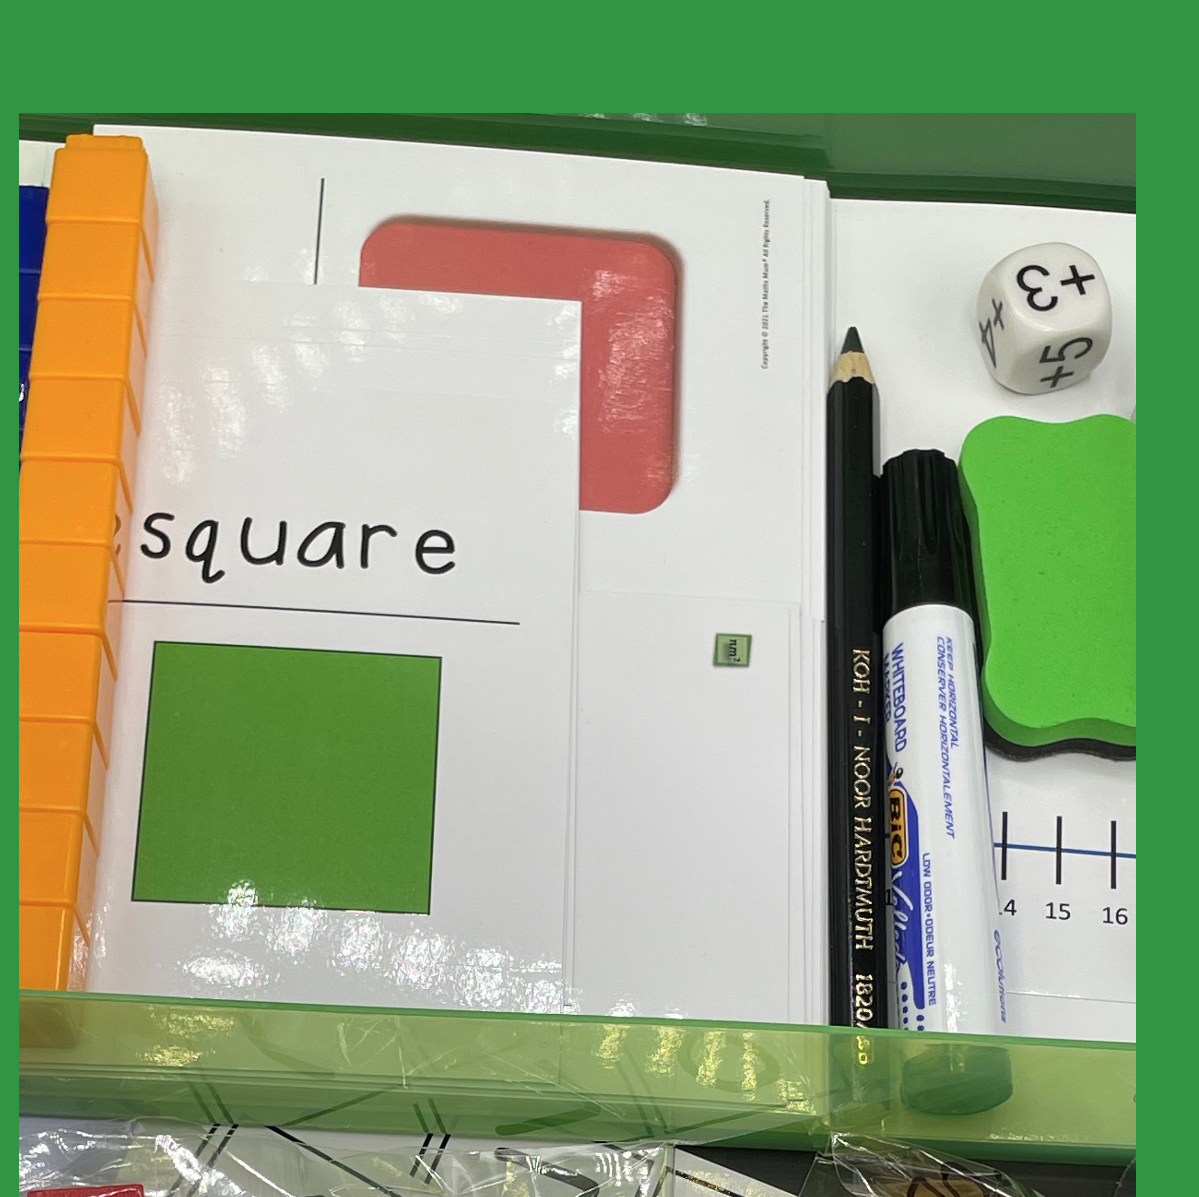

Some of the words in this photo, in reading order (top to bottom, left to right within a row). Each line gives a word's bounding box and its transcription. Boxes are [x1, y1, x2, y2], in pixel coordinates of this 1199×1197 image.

[139, 511, 457, 584] square
[852, 648, 871, 695] KOH
[936, 635, 948, 713] CONSERVER
[946, 636, 954, 671] KEEP
[891, 642, 907, 753] WHITEBOARD
[948, 674, 959, 750] HORIZONTAL
[853, 746, 872, 810] NOOR
[939, 714, 955, 839] HORIZONTALEMENT
[853, 816, 874, 950] HARDTMUTH
[1044, 902, 1072, 921] 15
[1101, 907, 1129, 926] 16
[922, 851, 931, 877] LOW
[927, 961, 937, 1006] NEUTRE
